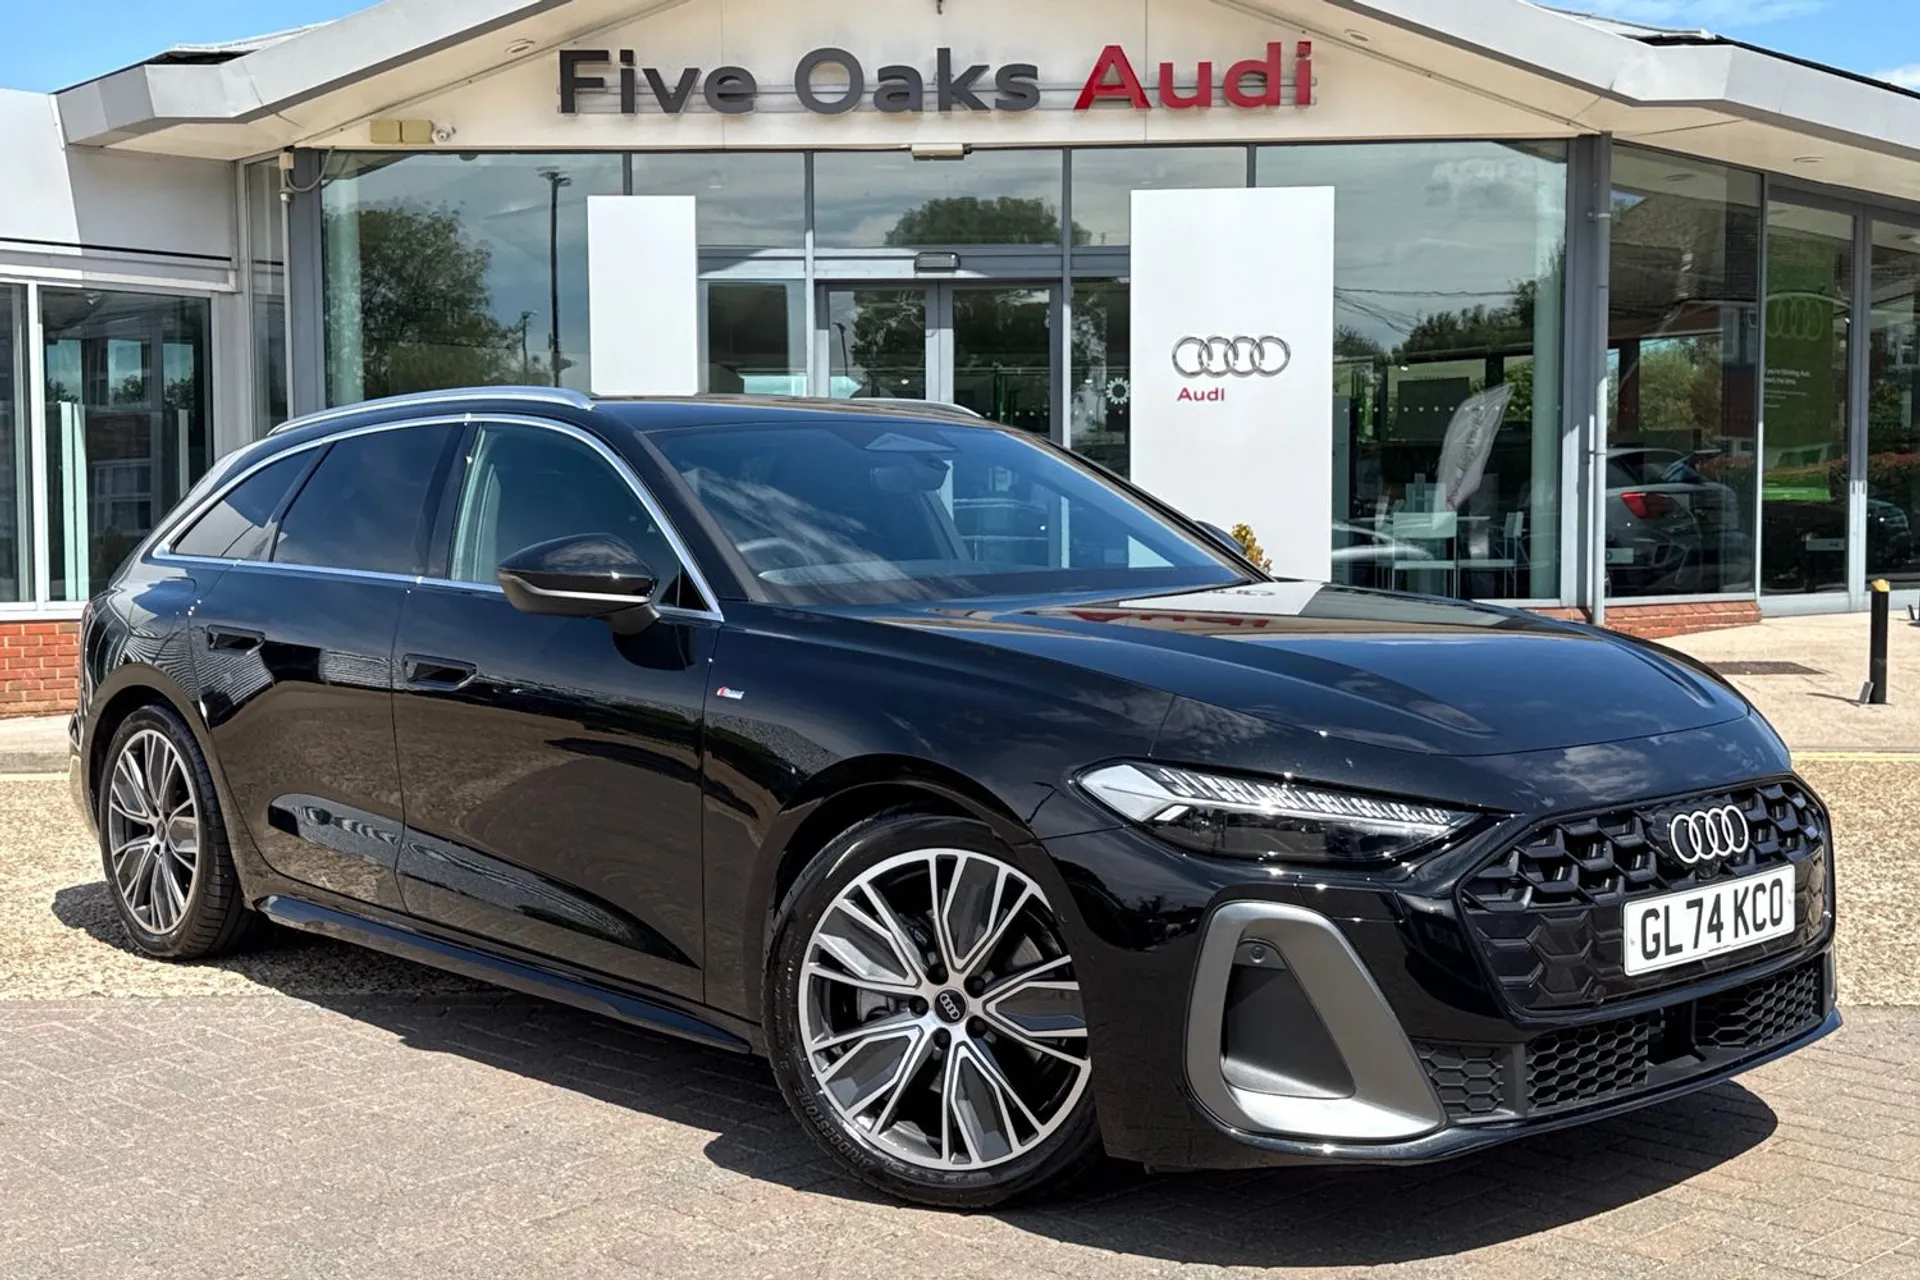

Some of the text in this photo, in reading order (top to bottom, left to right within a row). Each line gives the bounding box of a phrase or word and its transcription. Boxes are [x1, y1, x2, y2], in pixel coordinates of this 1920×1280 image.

[558, 40, 1313, 115] Five Oaks Audi
[1177, 386, 1225, 402] Audi
[1640, 877, 1784, 961] GL74 KCO
